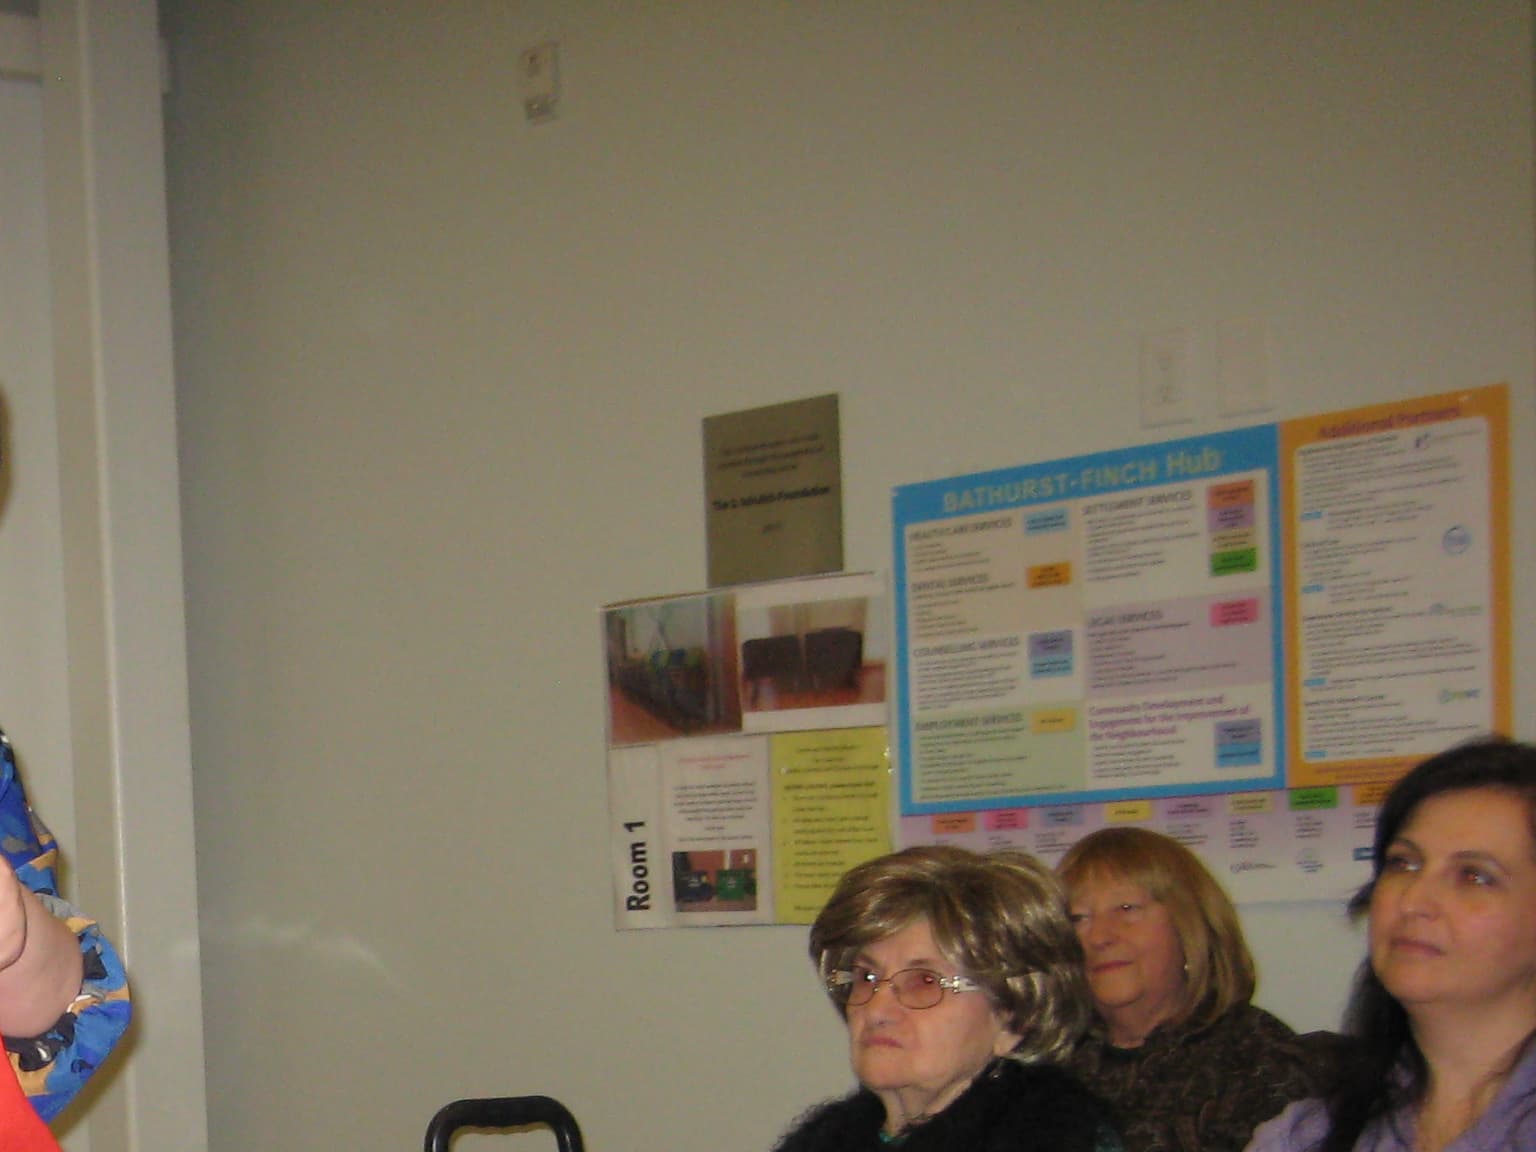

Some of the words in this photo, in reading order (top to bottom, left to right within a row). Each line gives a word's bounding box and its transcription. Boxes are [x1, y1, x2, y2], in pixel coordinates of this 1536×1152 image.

[1167, 447, 1222, 476] Hub
[624, 821, 645, 832] 1
[626, 842, 650, 910] Room
